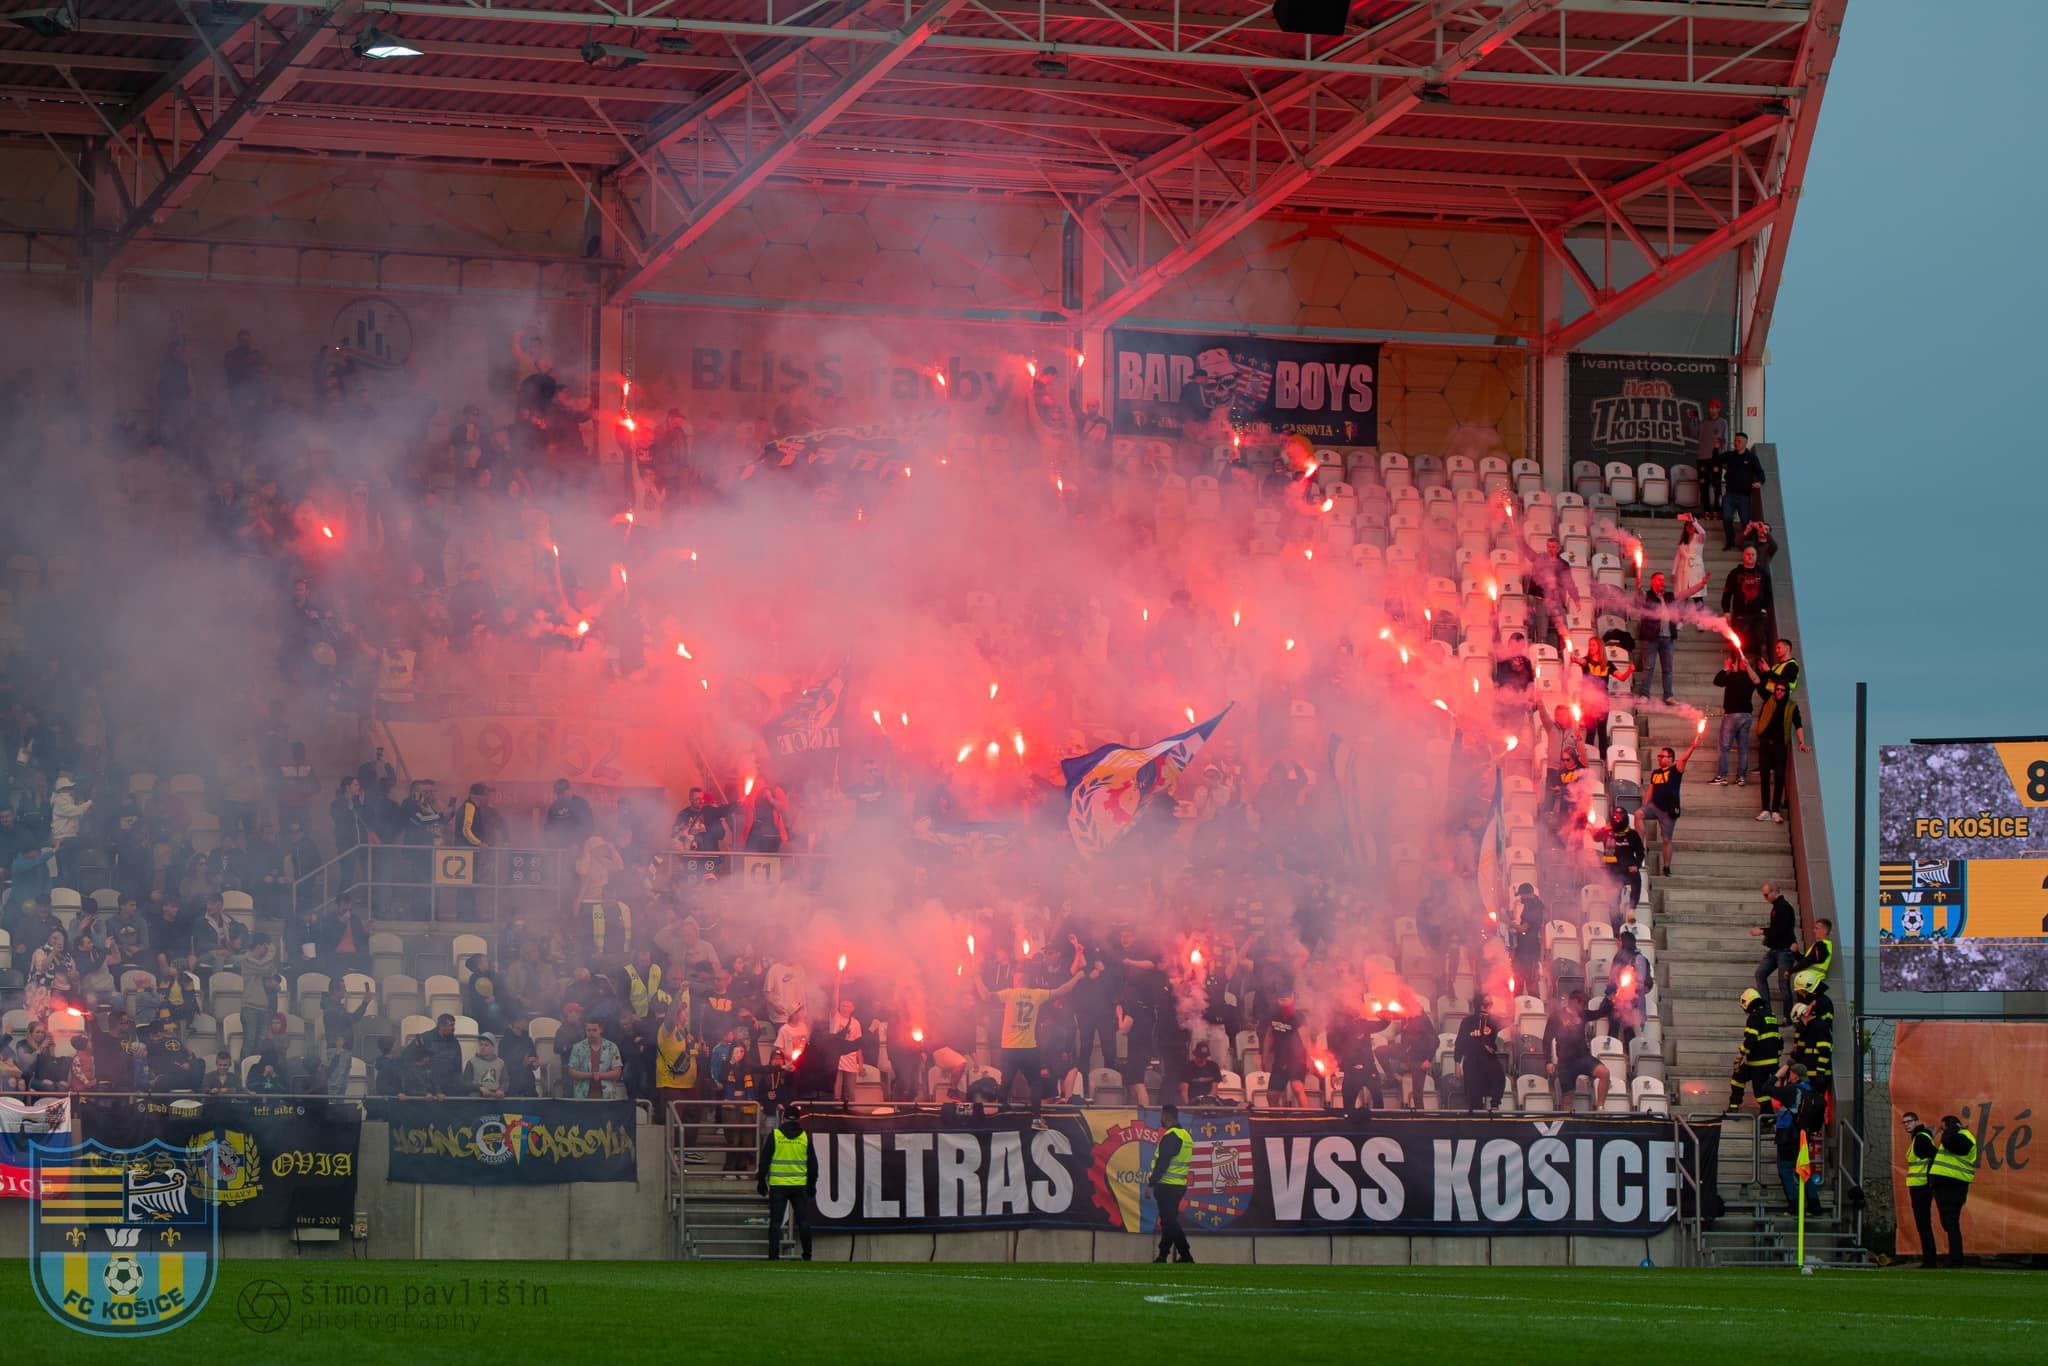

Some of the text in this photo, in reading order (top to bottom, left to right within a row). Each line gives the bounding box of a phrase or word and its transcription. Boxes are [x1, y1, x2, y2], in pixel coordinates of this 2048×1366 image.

[691, 347, 843, 397] BLISS
[1582, 356, 1717, 374] ivantattoo.com
[1118, 351, 1373, 412] BAD BOYS
[1624, 379, 1672, 398] ivan
[1608, 420, 1685, 443] KOSICE
[1916, 812, 2029, 838] FC KOŠICE
[442, 855, 467, 880] C2
[1016, 1001, 1034, 1023] 12
[1119, 1128, 1160, 1143] TJ VSS
[271, 1150, 353, 1177] OVIA
[811, 1128, 1073, 1219] ULTRAS
[1264, 1120, 1684, 1223] VSS KOŠICE
